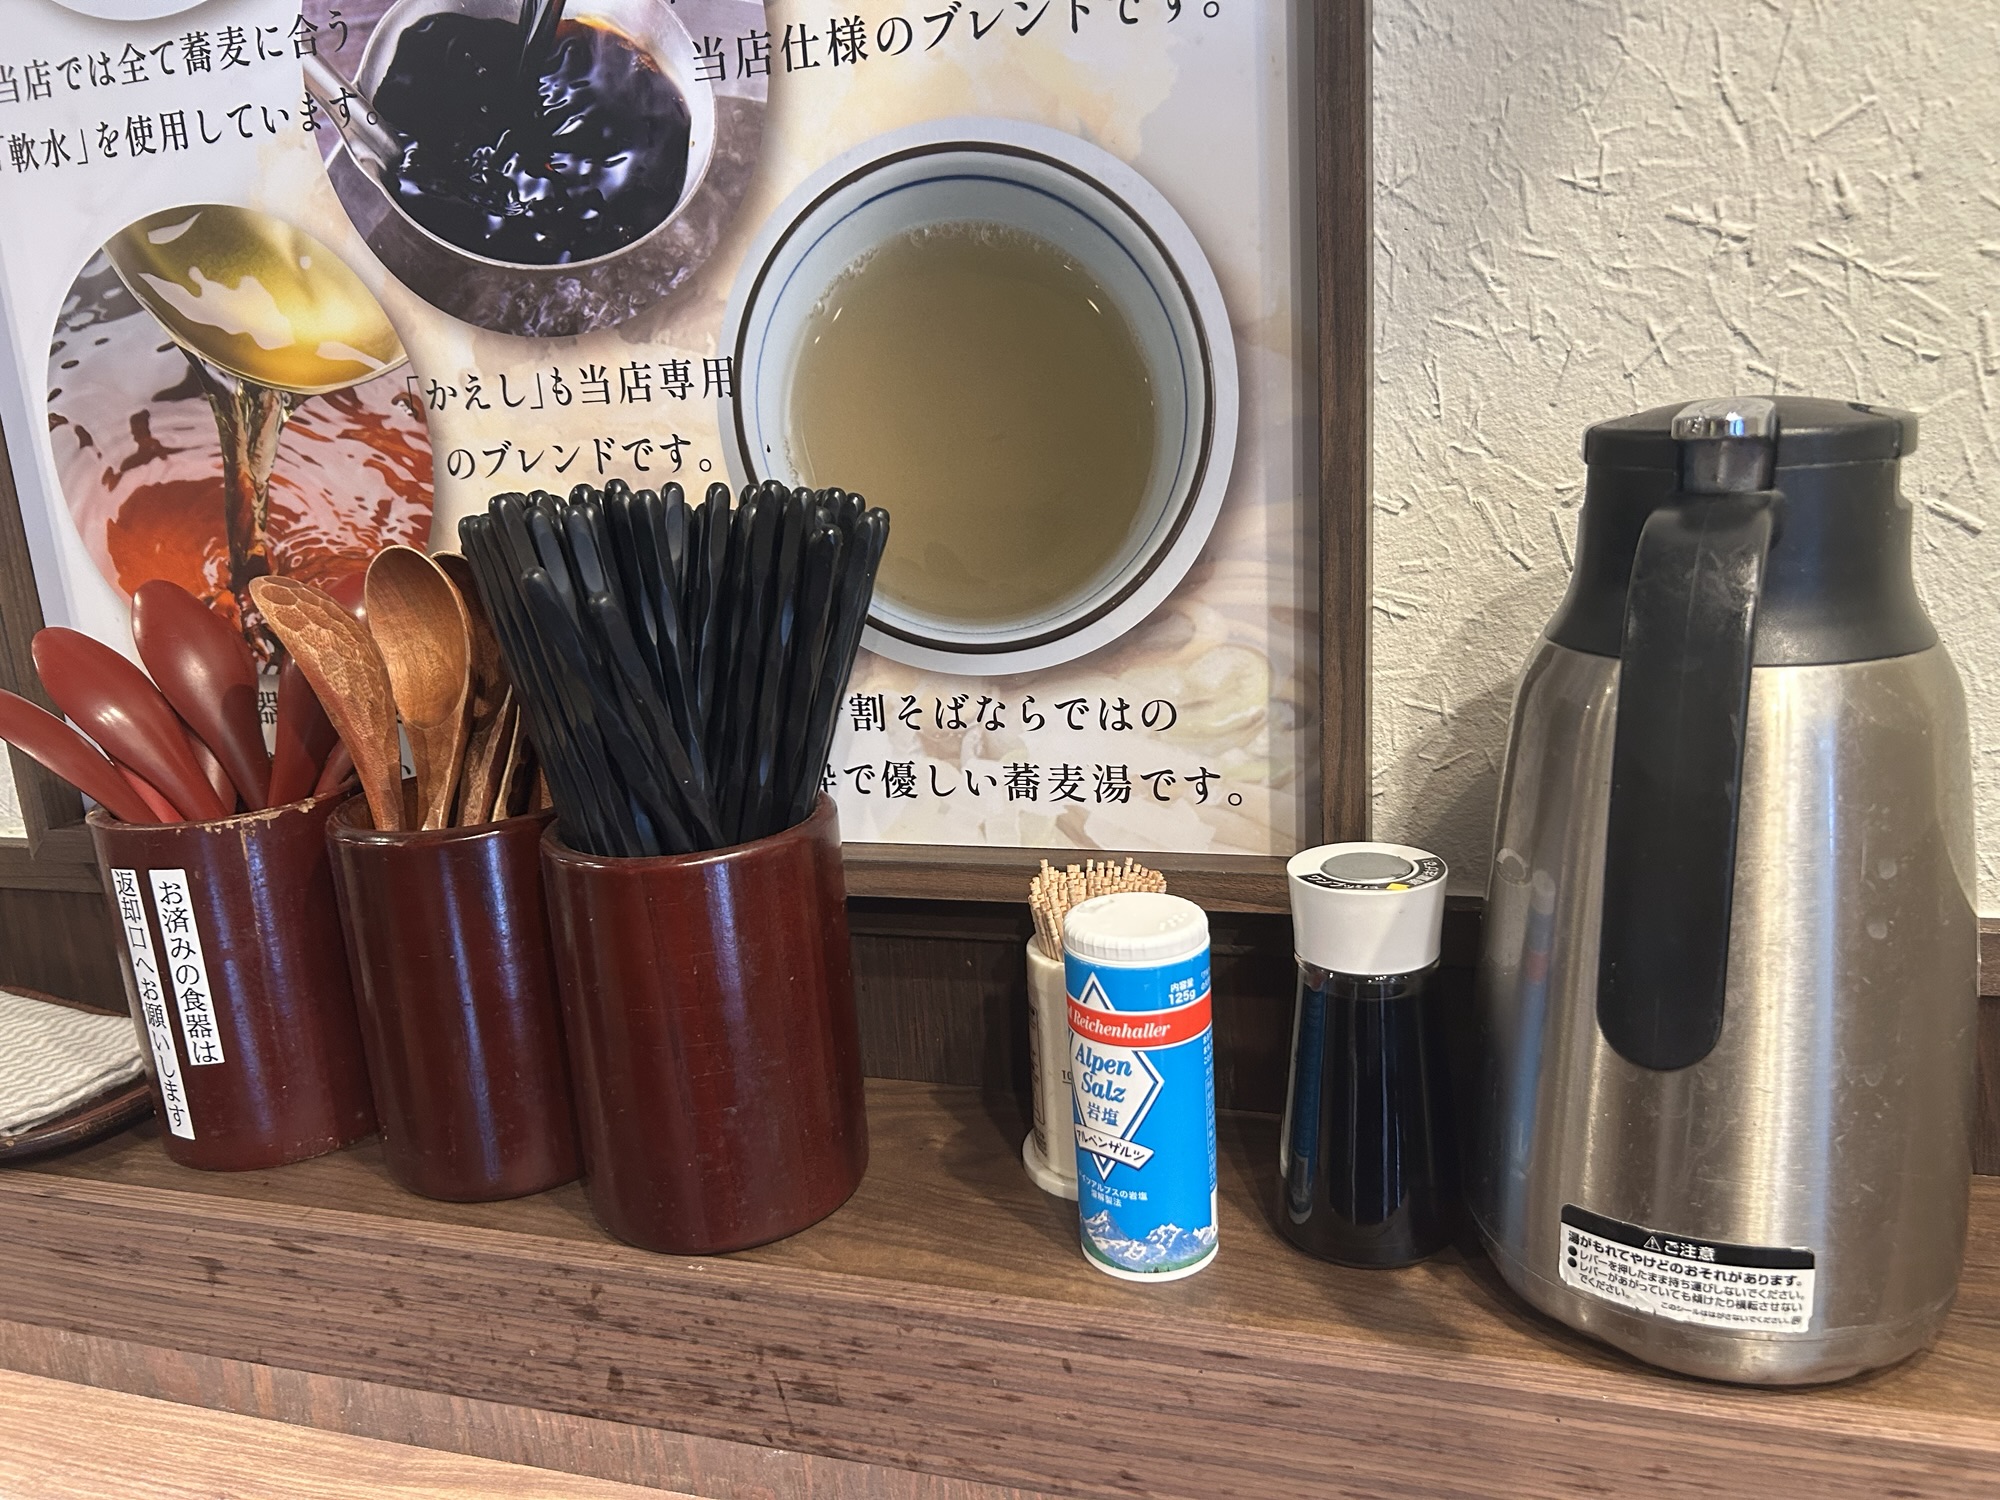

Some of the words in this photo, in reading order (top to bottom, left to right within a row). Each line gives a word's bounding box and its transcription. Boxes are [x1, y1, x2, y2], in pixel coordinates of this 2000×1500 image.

[0, 9, 349, 104] 当店では全て蕎麦に合う
[406, 355, 734, 412] 「かえし」も当店専用
[447, 433, 712, 480] のブレンドです。
[841, 693, 1178, 733] 割そばならではの
[158, 881, 219, 1063] お済みの食器は
[1170, 977, 1194, 993] 内容量
[115, 871, 186, 1128] 返却口へお願いします
[1168, 989, 1196, 1005] 125g
[1073, 1009, 1171, 1039] Reichenhaller
[1075, 1042, 1133, 1075] Alpen
[1081, 1072, 1126, 1102] Salz
[1087, 1102, 1119, 1126] 岩塩
[1567, 1229, 1803, 1288] 湯がもれてやけどのおそれがあります。
[1663, 1240, 1715, 1262] ご注意
[1579, 1250, 1806, 1301] レバーを押したまま持ち運びしないでください。
[1579, 1274, 1632, 1299] でください。
[1579, 1262, 1803, 1312] レバーがあがっていても傾けたり横転させない
